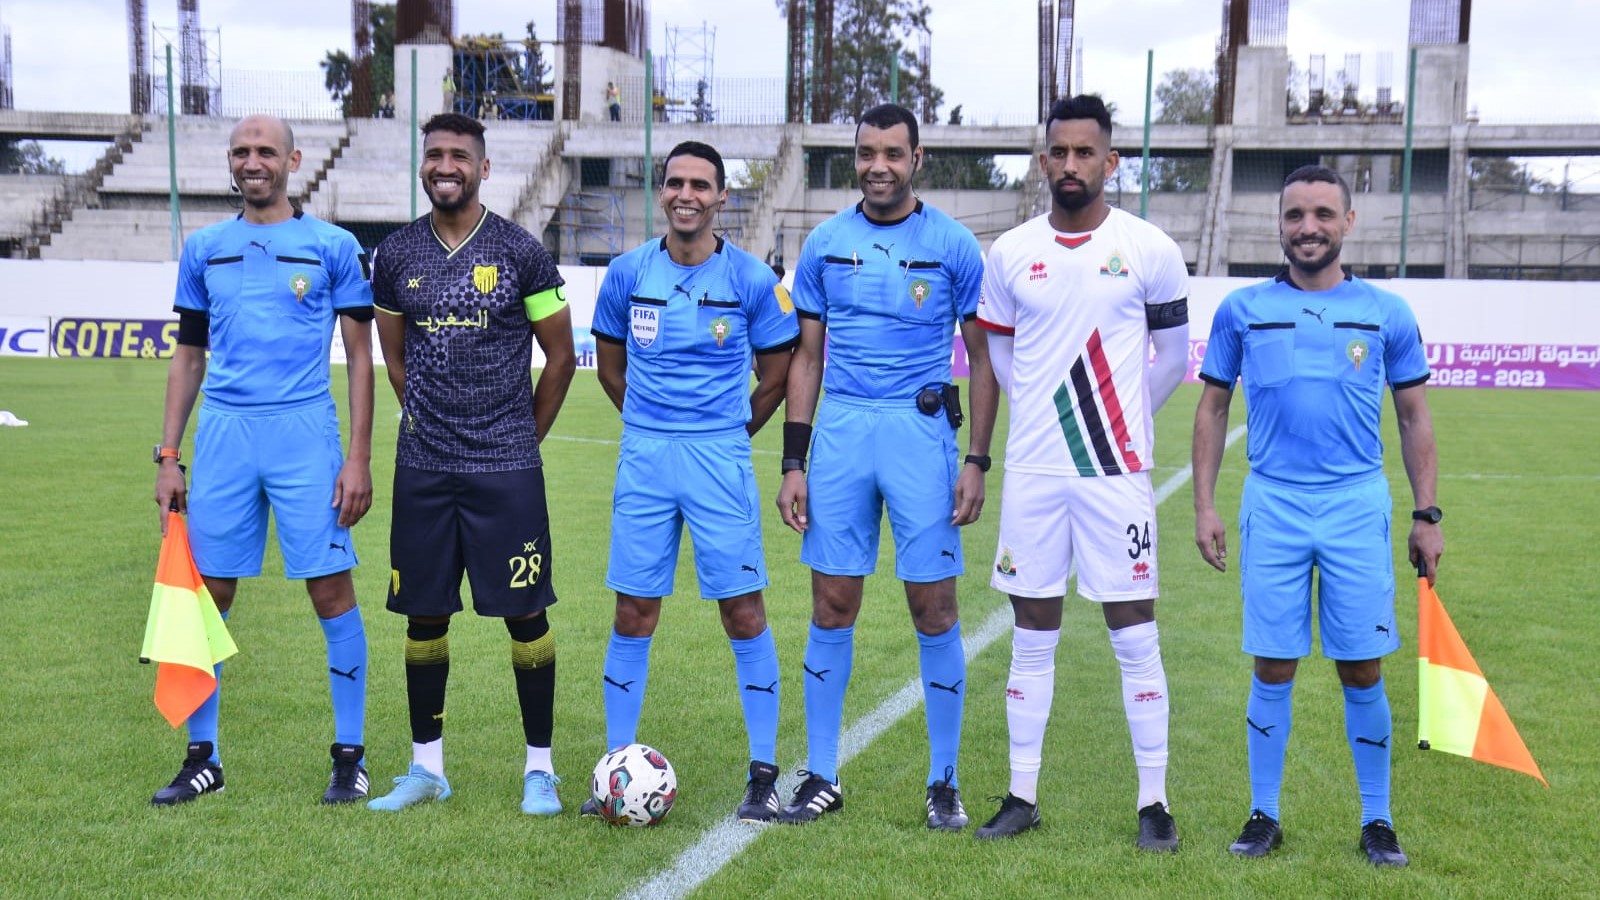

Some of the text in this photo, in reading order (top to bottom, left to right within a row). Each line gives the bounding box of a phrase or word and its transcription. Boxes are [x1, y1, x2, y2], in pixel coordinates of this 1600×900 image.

[633, 308, 656, 321] FIFA
[633, 324, 656, 333] REFEREE
[1425, 368, 1478, 386] 2022
[1494, 370, 1546, 387] 2023
[1127, 520, 1151, 560] 34
[508, 553, 542, 588] 28
